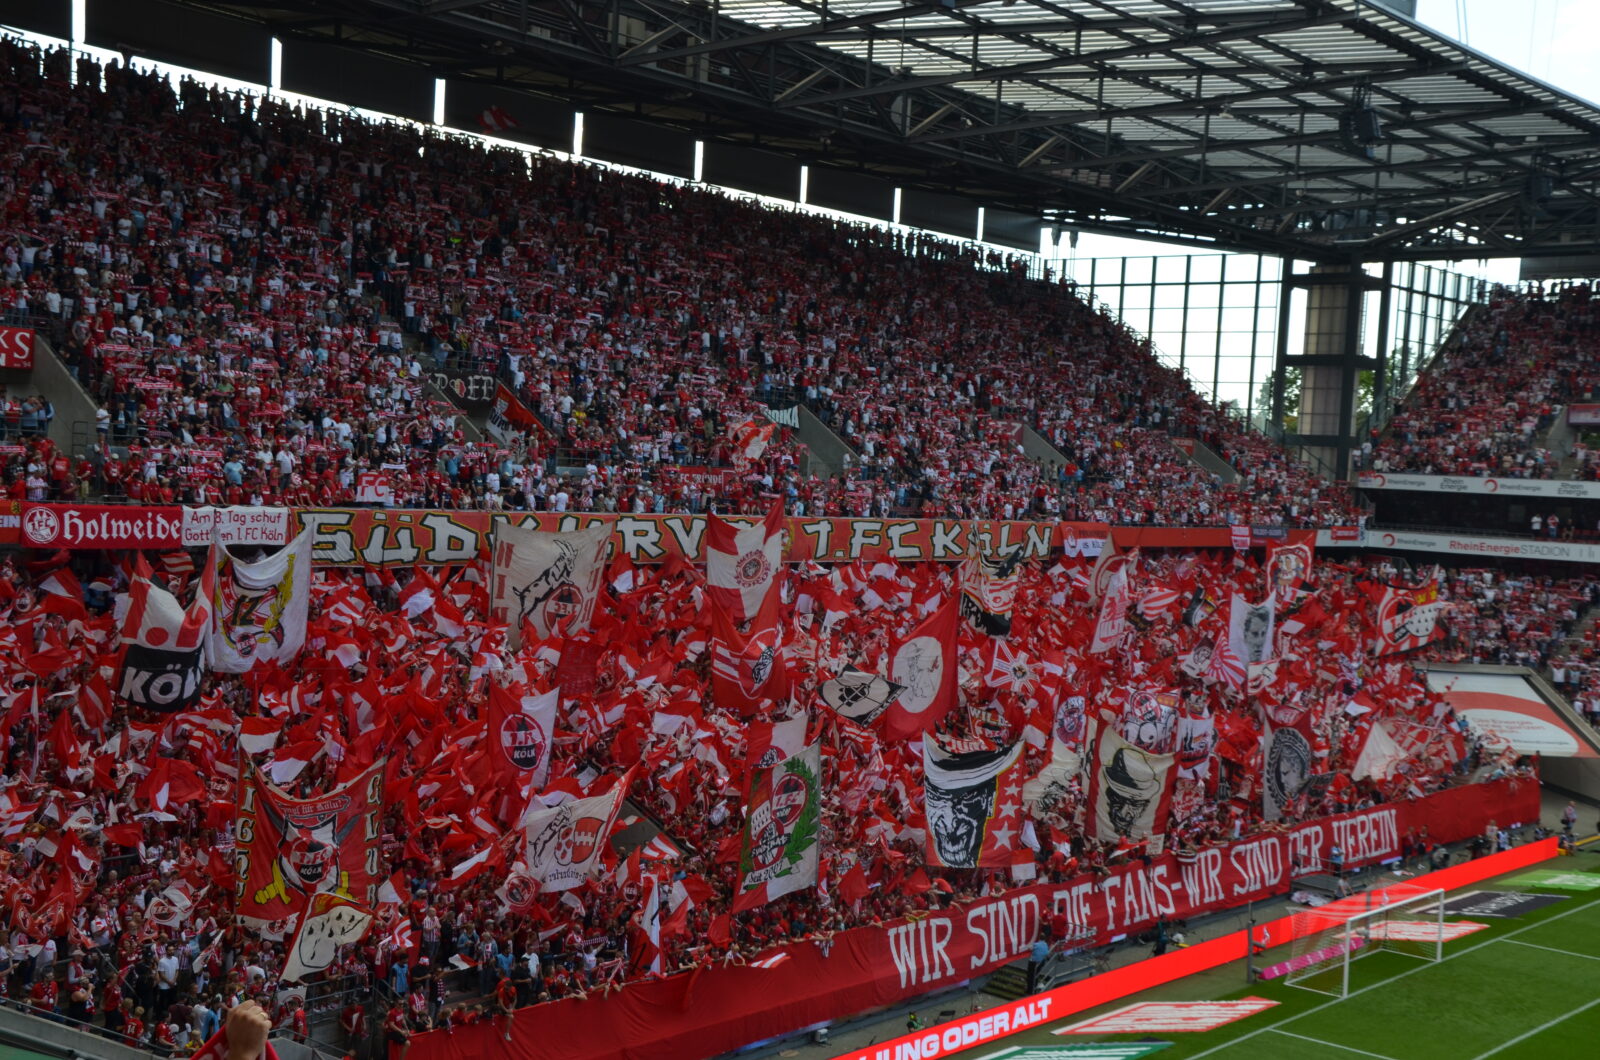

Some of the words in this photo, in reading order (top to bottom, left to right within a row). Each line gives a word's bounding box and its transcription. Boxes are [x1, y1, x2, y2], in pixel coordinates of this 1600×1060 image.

[361, 476, 387, 497] FC
[1440, 483, 1468, 492] Energie
[1558, 488, 1588, 497] Energie
[63, 509, 181, 544] Holweide
[191, 511, 210, 524] Am
[227, 510, 246, 526] Tag
[250, 510, 281, 524] schuf
[185, 528, 210, 541] Gott
[261, 527, 283, 541] Köln
[803, 520, 922, 558] 1.FC
[887, 917, 956, 989] WIR
[966, 893, 1040, 970] SIND
[1053, 882, 1097, 943] DIE
[1230, 837, 1283, 897] SIND
[1288, 825, 1324, 877] DER
[1332, 808, 1399, 863] VEREIN
[942, 1016, 1010, 1052] ODER
[1011, 997, 1052, 1029] ALT
